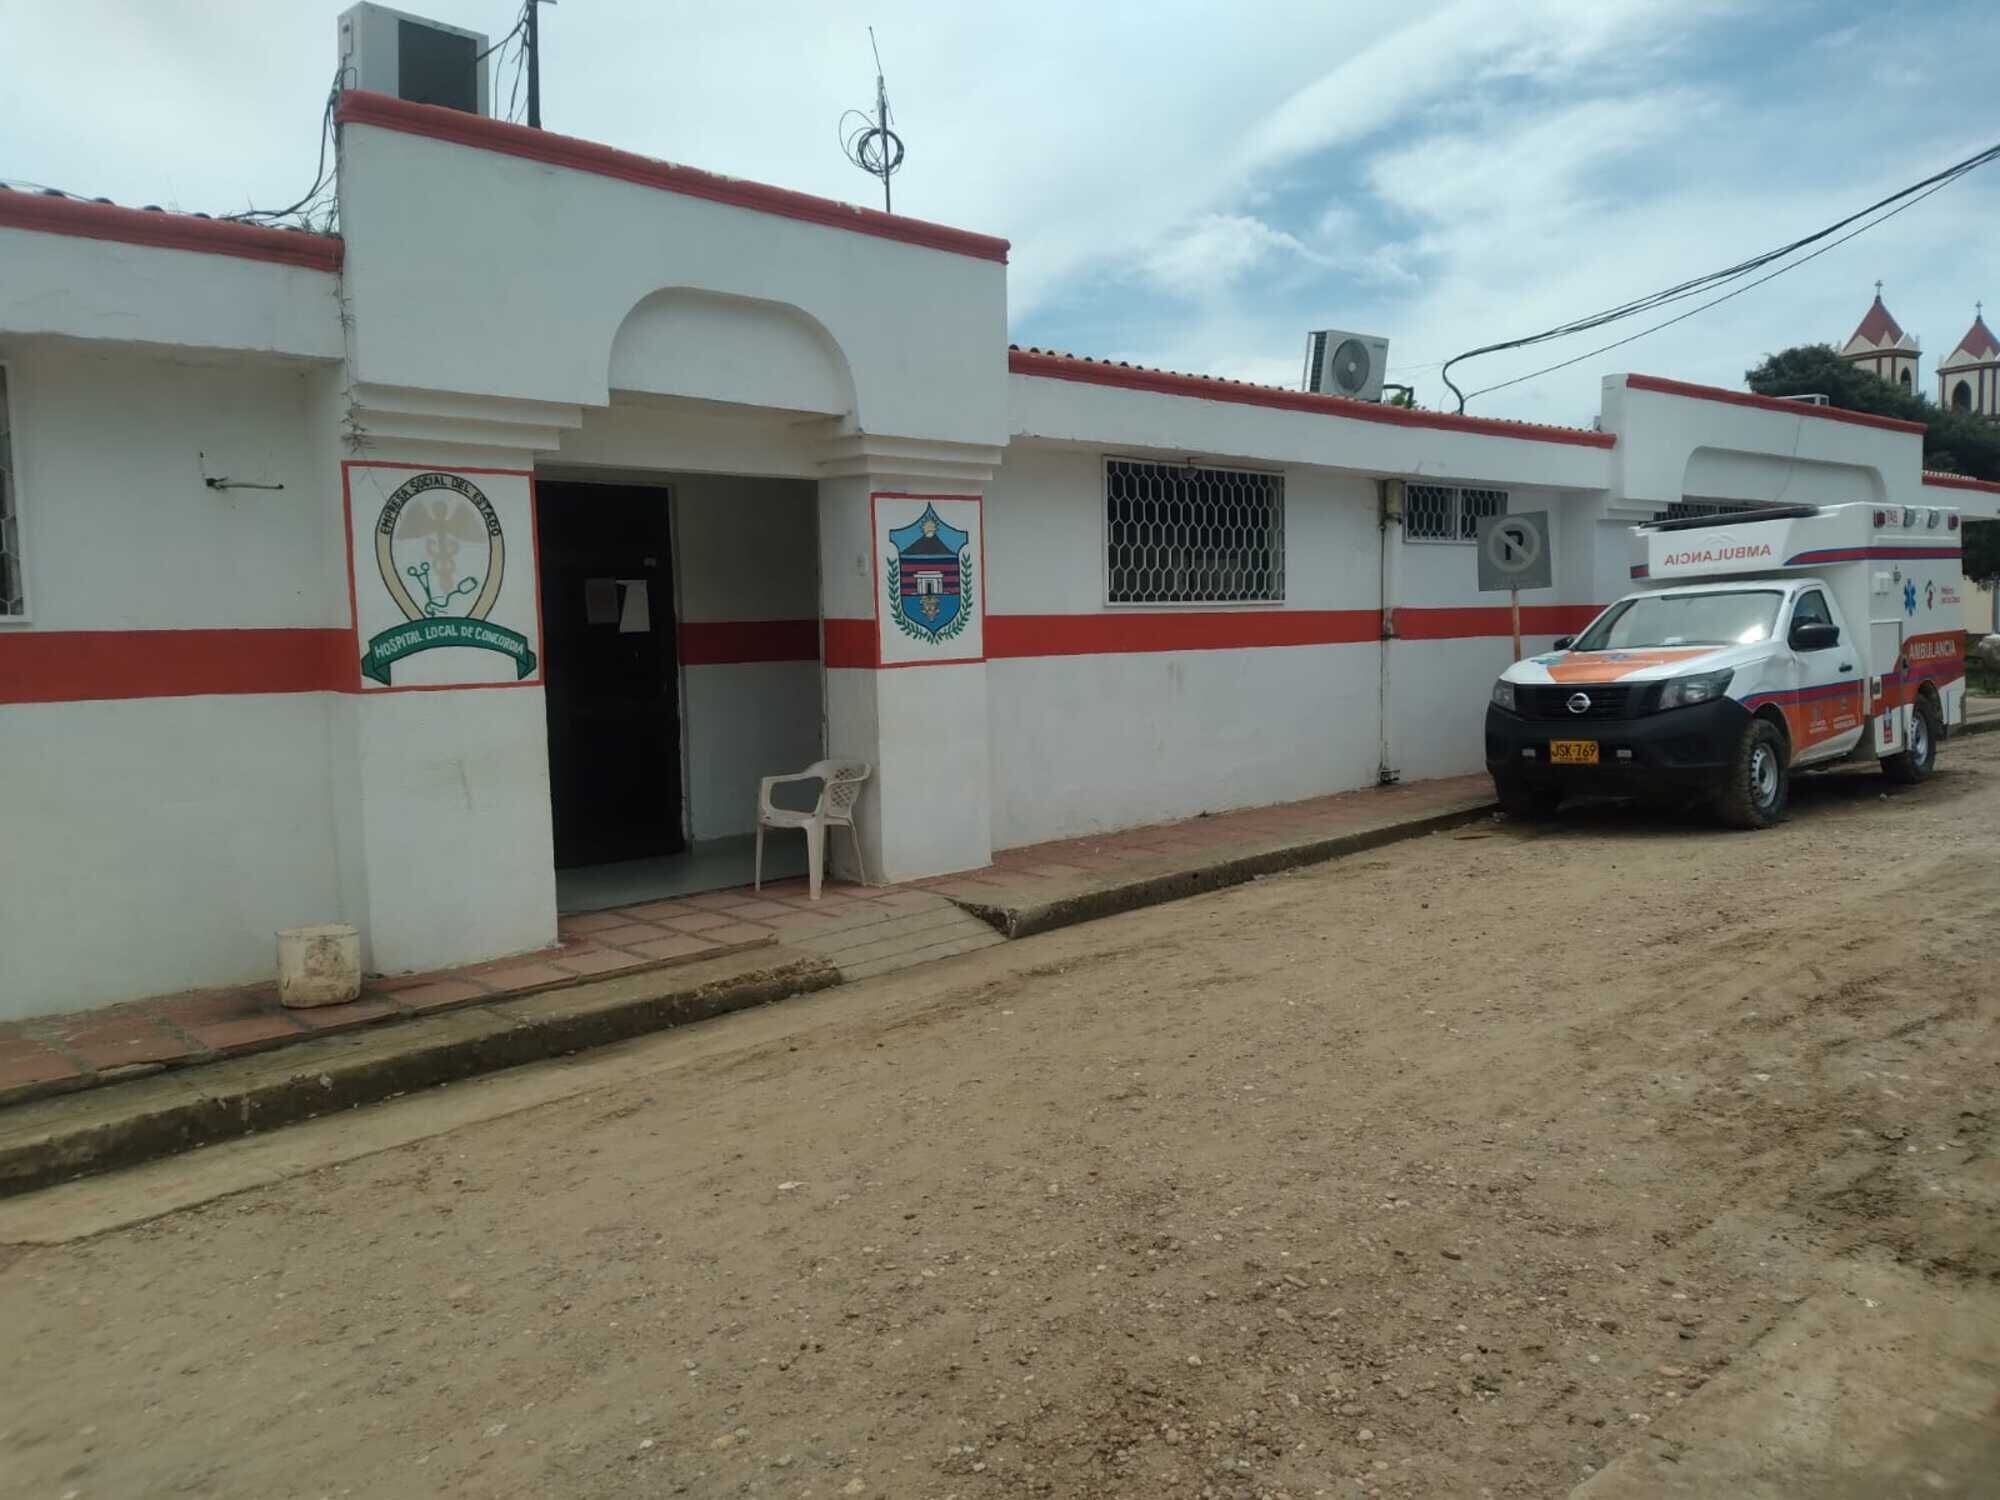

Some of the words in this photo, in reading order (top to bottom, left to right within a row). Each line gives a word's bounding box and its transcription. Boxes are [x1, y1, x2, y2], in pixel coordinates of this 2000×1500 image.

[380, 488, 412, 535] EMPRESA
[410, 476, 447, 490] SOCIAL
[451, 477, 470, 493] DEL
[473, 491, 502, 537] ESTADO
[1504, 530, 1524, 561] P
[374, 630, 424, 658] HOSPITAL
[425, 624, 459, 640] LOCAL
[460, 626, 473, 638] DE
[474, 627, 525, 657] CONCORDIA
[1909, 640, 1957, 659] AMBULANCIA
